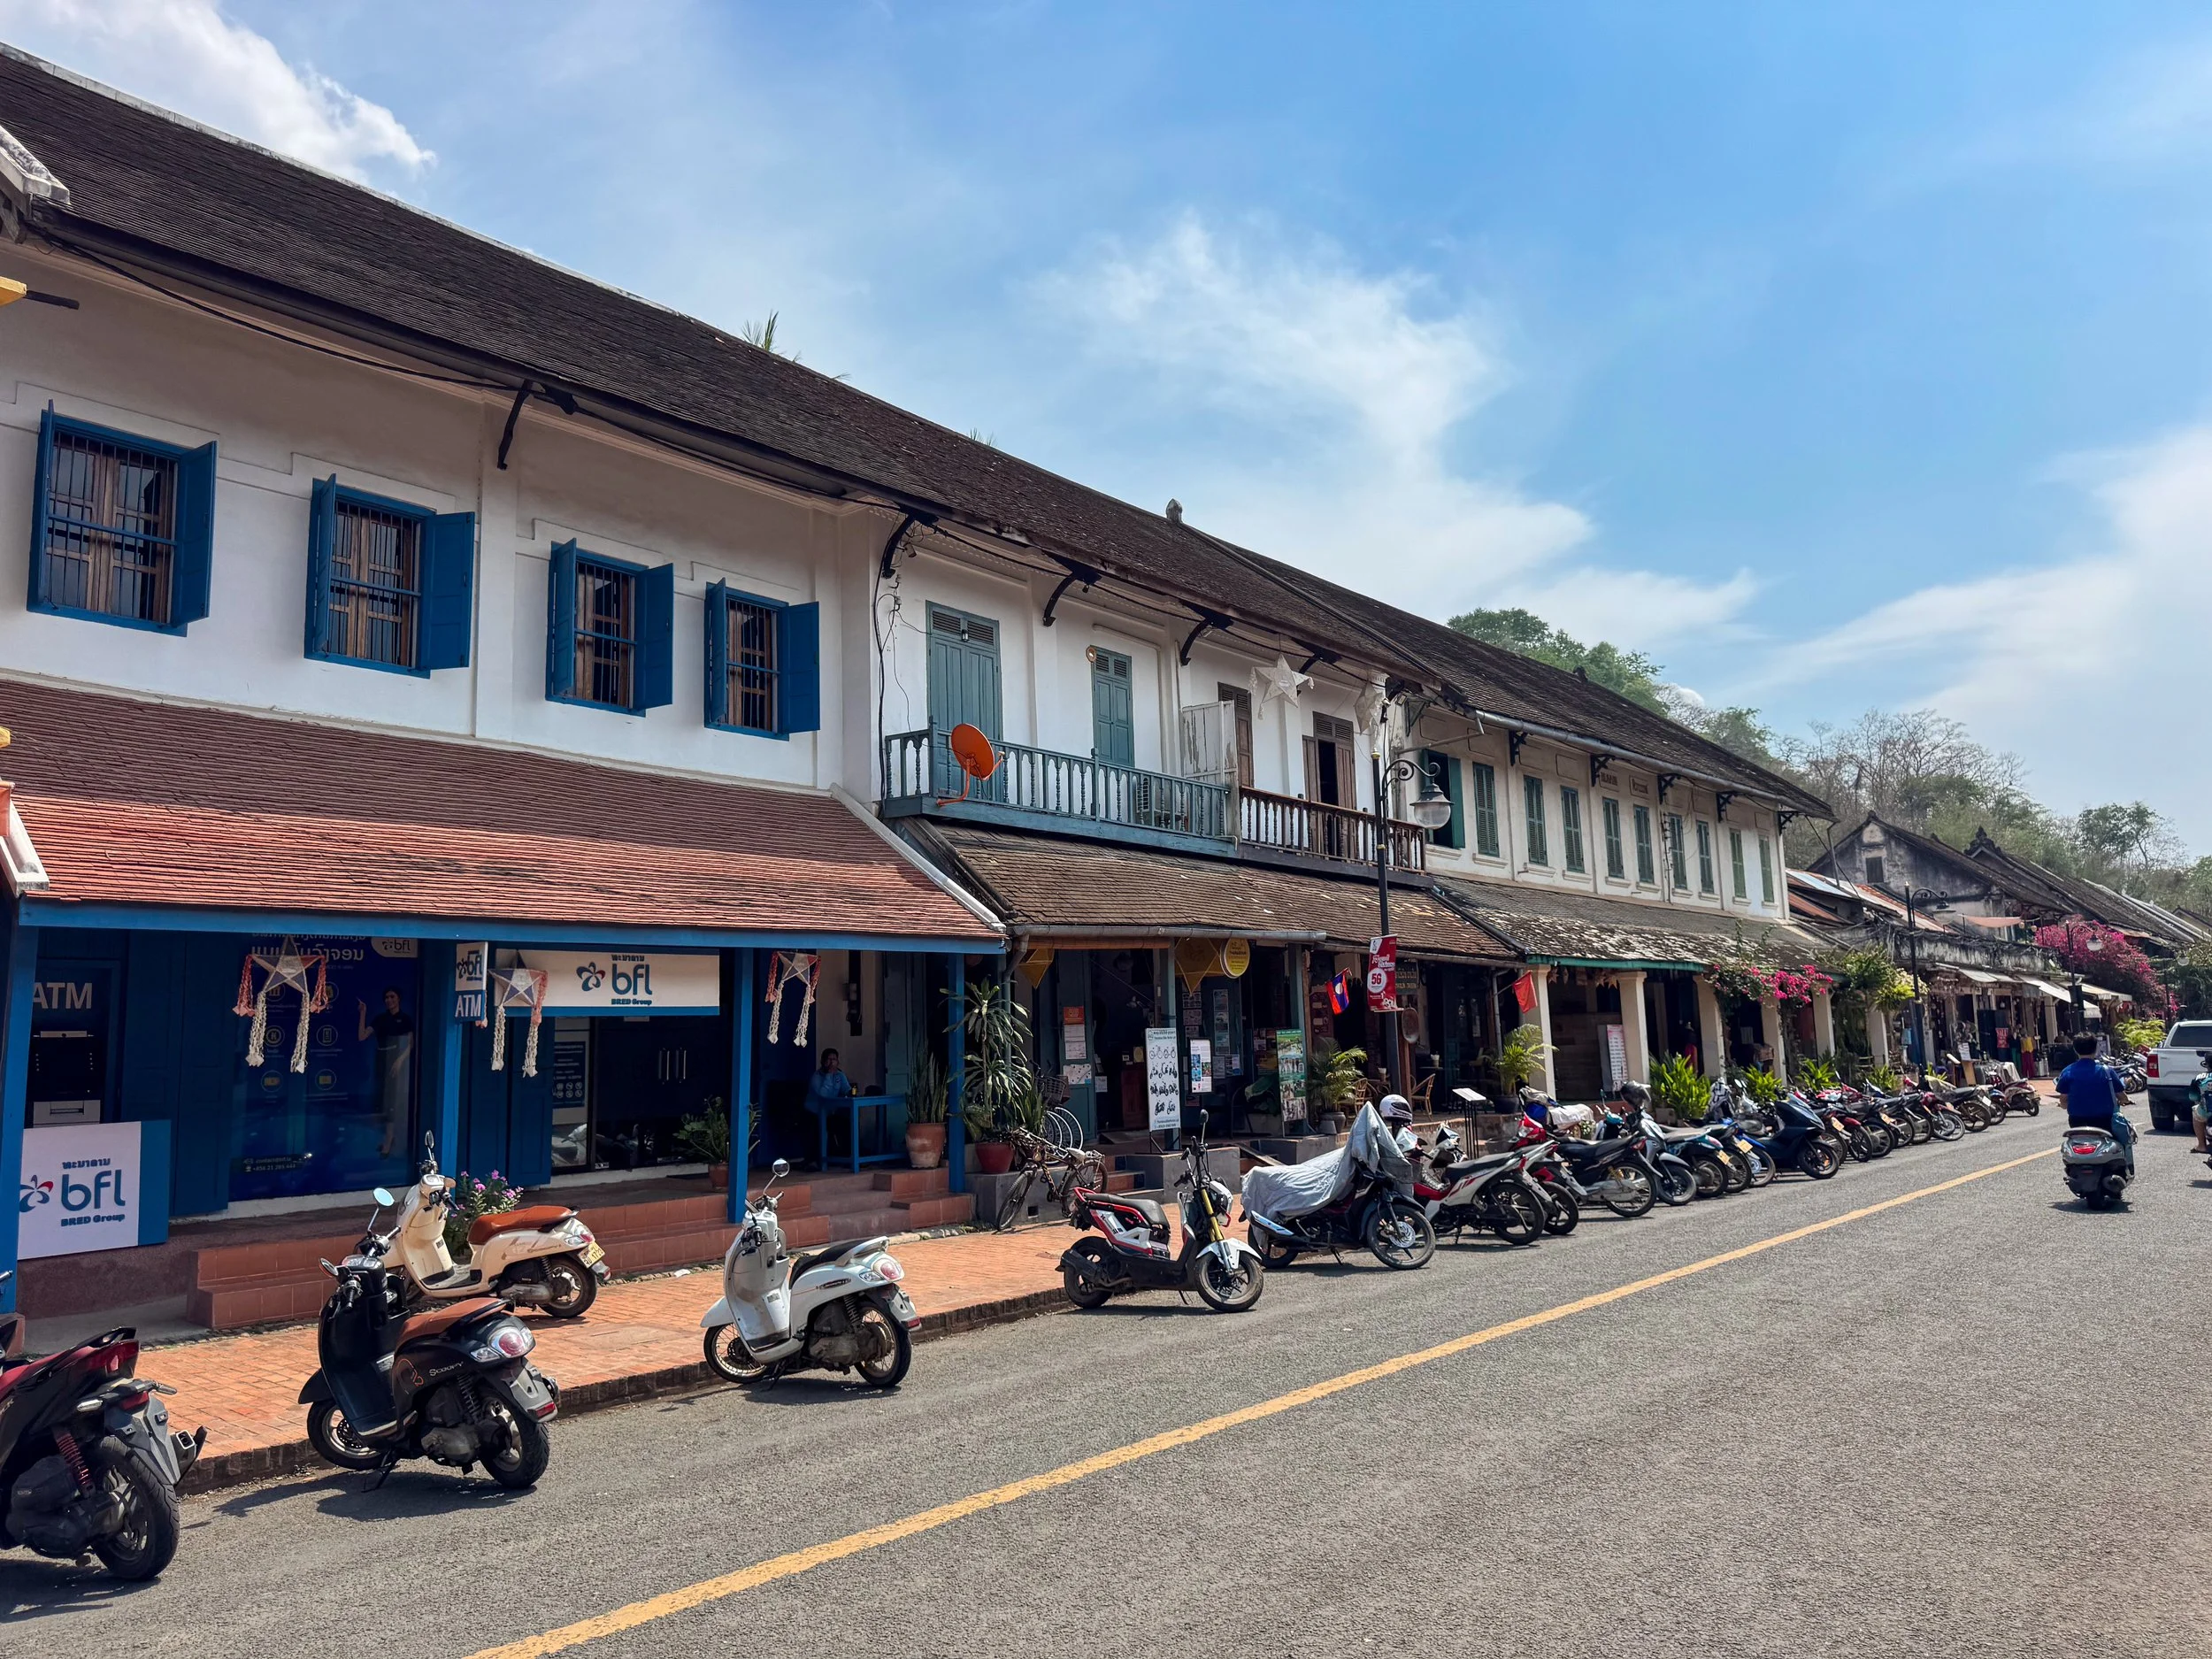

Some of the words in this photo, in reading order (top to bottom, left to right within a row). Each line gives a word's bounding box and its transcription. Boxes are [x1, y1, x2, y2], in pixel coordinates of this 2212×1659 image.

[612, 964, 652, 995] bfl
[34, 982, 92, 1009] ATM
[455, 995, 481, 1017] ATM
[61, 1170, 126, 1211] bfl
[61, 1216, 91, 1226] BRED
[93, 1214, 126, 1223] Group
